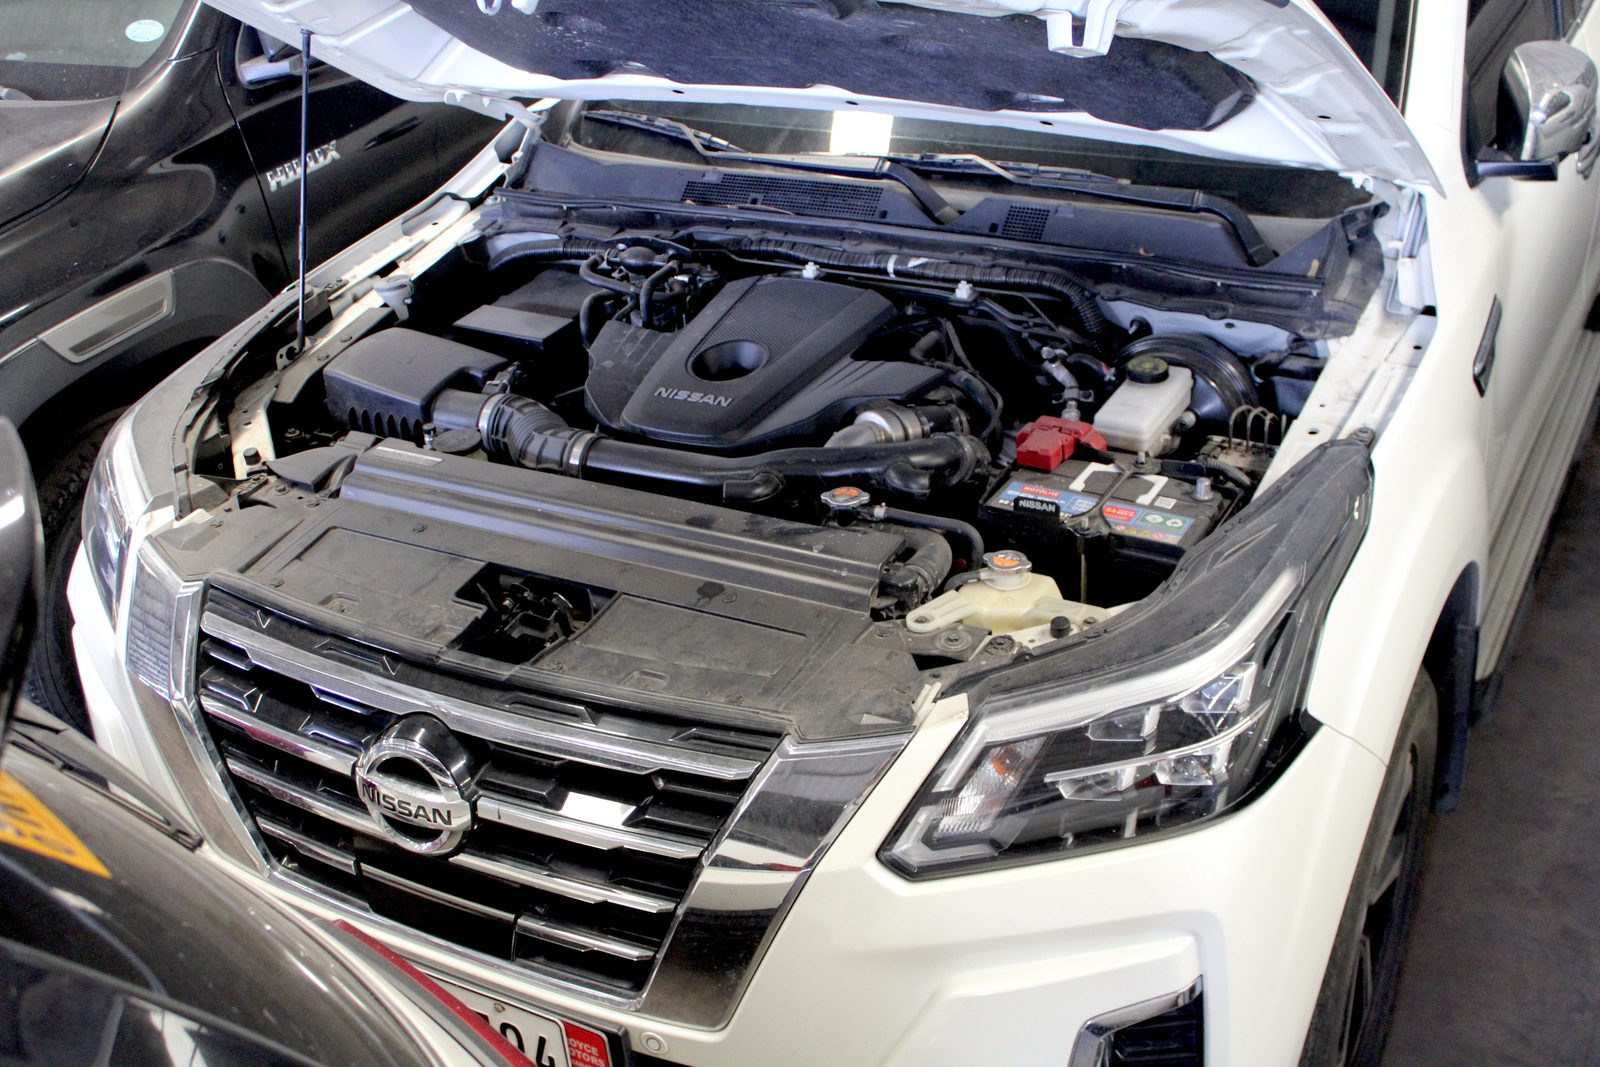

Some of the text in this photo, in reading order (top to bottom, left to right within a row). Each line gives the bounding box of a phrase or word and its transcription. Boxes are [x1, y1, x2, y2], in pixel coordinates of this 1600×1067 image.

[266, 140, 341, 192] HILUX
[654, 386, 732, 407] NISSAN
[1018, 499, 1057, 513] NISSAN
[361, 783, 453, 826] NISSAN
[567, 1038, 600, 1057] OYCE
[568, 1047, 606, 1067] OTORS
